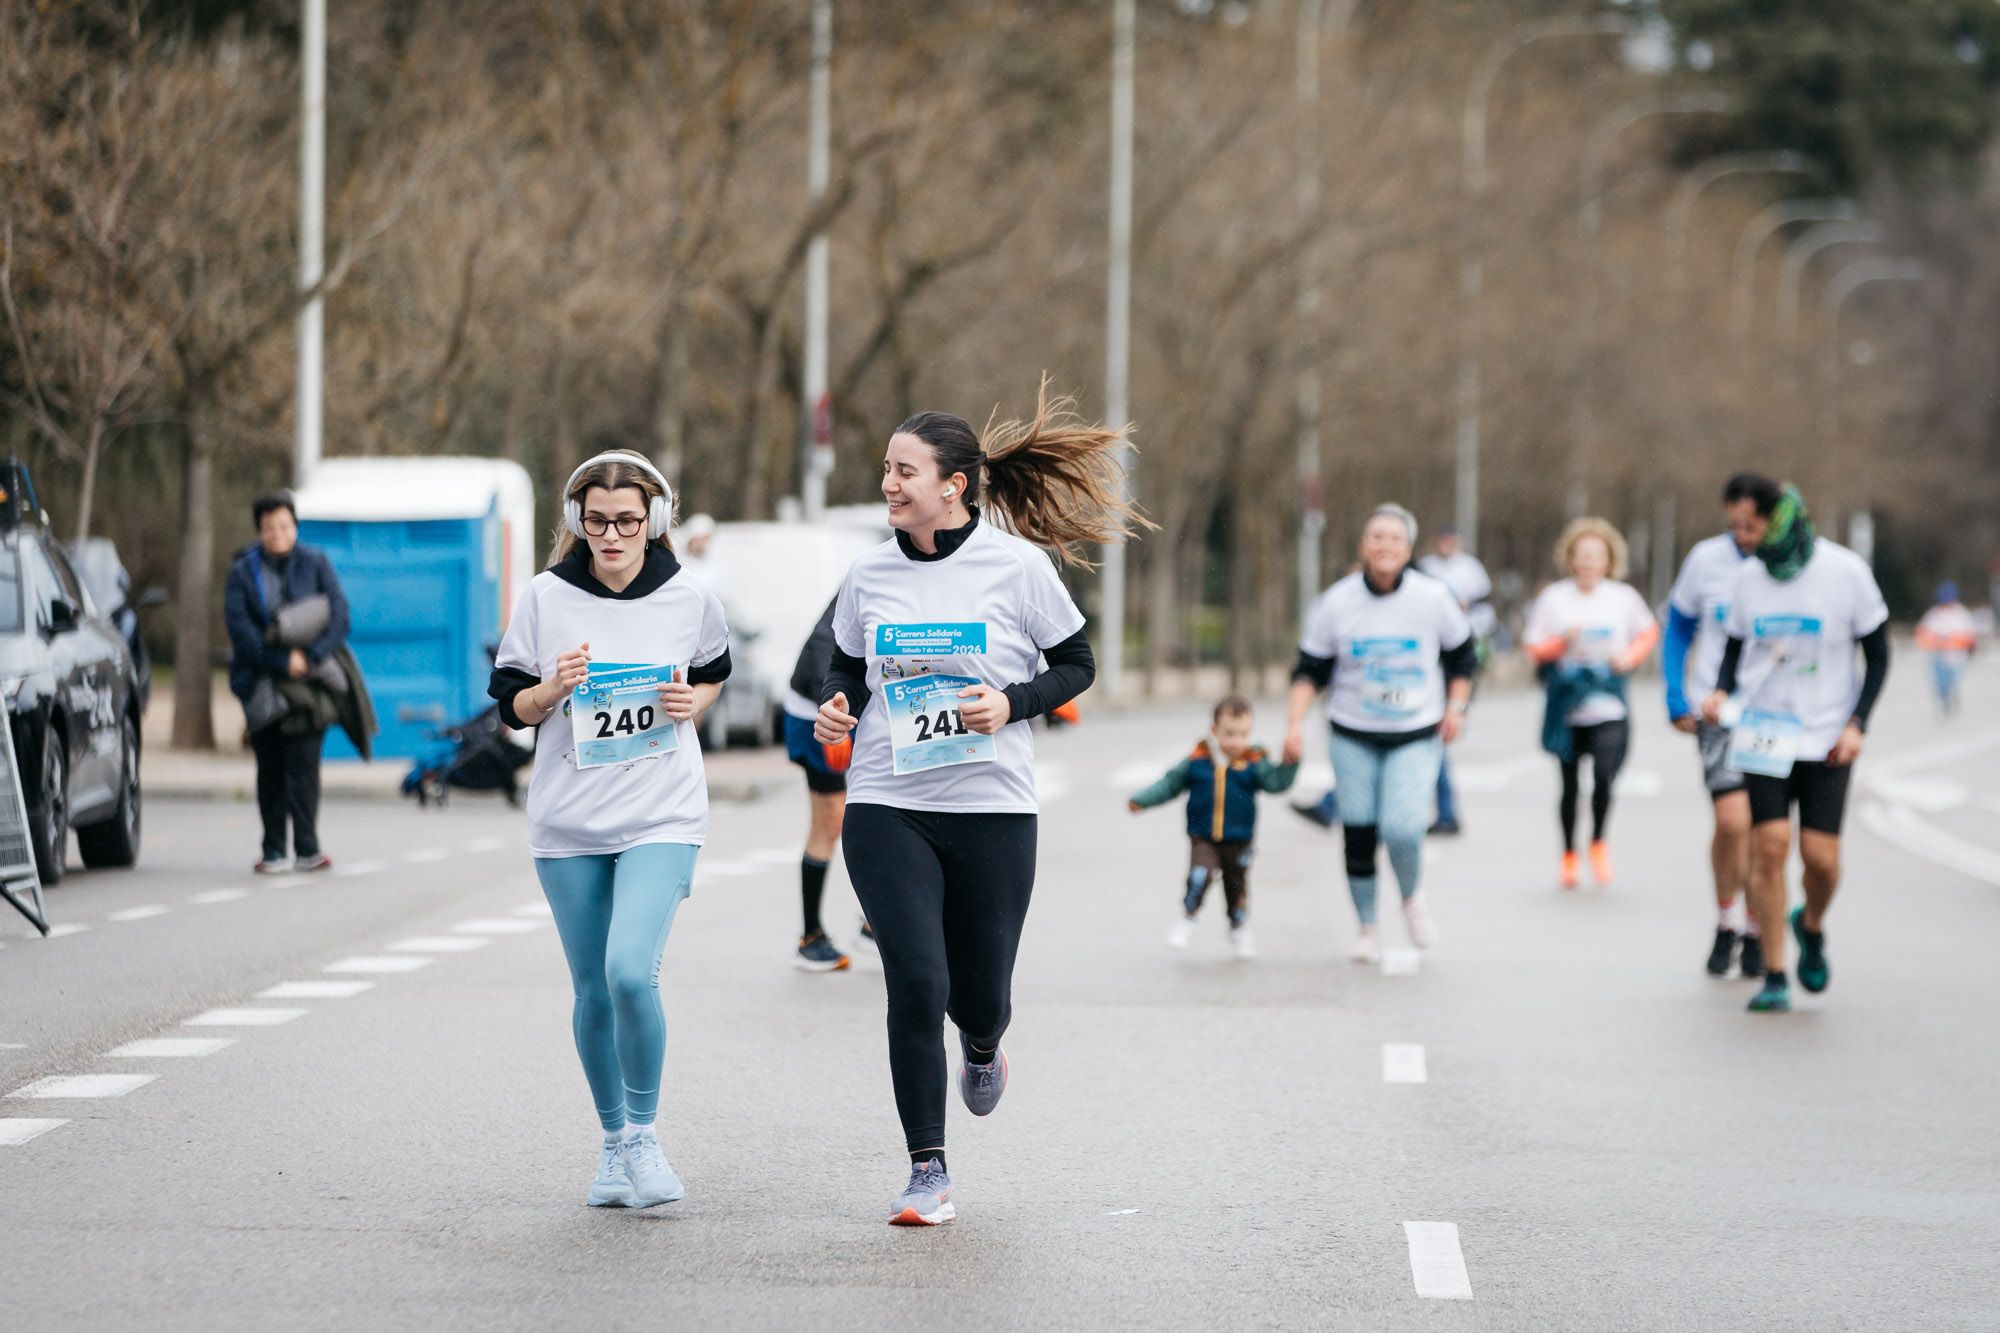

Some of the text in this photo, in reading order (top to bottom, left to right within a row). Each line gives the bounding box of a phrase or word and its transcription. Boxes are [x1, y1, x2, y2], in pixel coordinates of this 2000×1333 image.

[895, 630, 925, 638] Carrera
[927, 628, 962, 637] Solidaria
[952, 645, 982, 655] 2026
[590, 681, 621, 690] Carrera
[623, 675, 658, 686] Solidaria
[905, 684, 934, 694] Carrera
[934, 680, 969, 689] Solidaria
[594, 705, 655, 738] 240
[914, 709, 968, 742] 241
